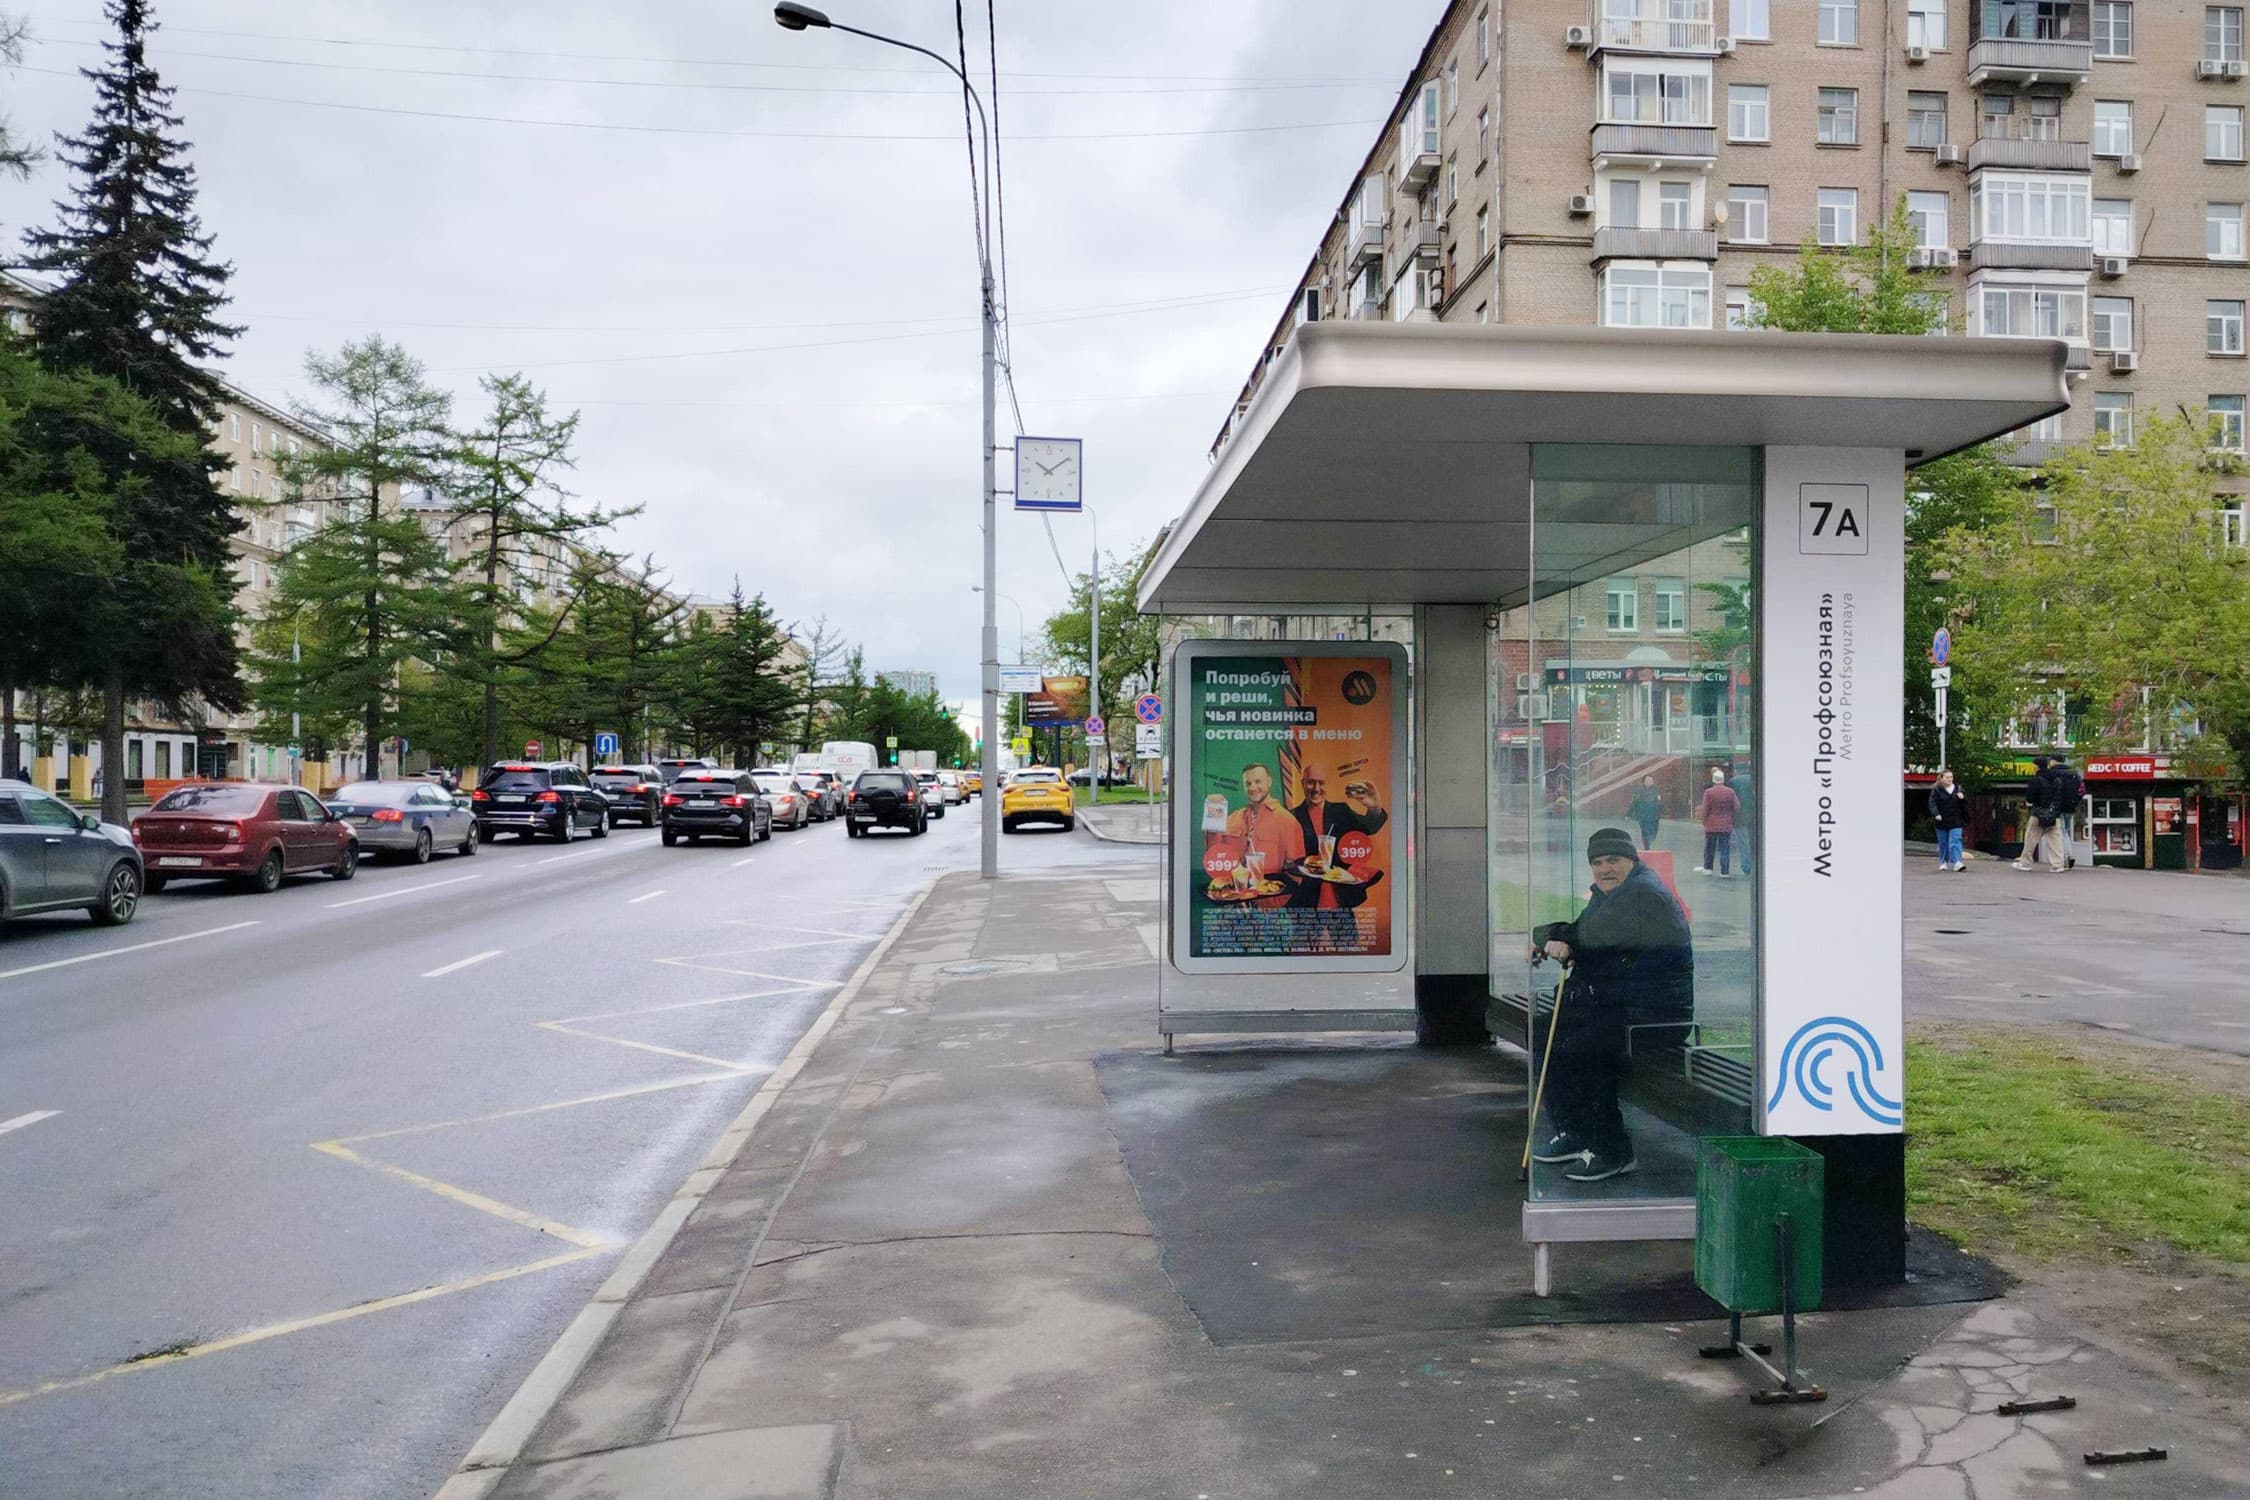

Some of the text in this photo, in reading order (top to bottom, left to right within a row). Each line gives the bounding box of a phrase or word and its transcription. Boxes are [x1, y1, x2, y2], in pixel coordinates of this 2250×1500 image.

[1809, 501, 1860, 537] 7А
[1205, 669, 1292, 687] Попробуй
[1839, 593, 1856, 760] Metro Profsoyuznaya
[1205, 692, 1273, 705] и реши,
[1205, 710, 1315, 722] чья новинка
[1205, 729, 1362, 741] останется в меню
[1813, 593, 1836, 878] Метро «Профсоюзная»
[2105, 763, 2121, 773] CT
[2121, 763, 2152, 773] COFFEE
